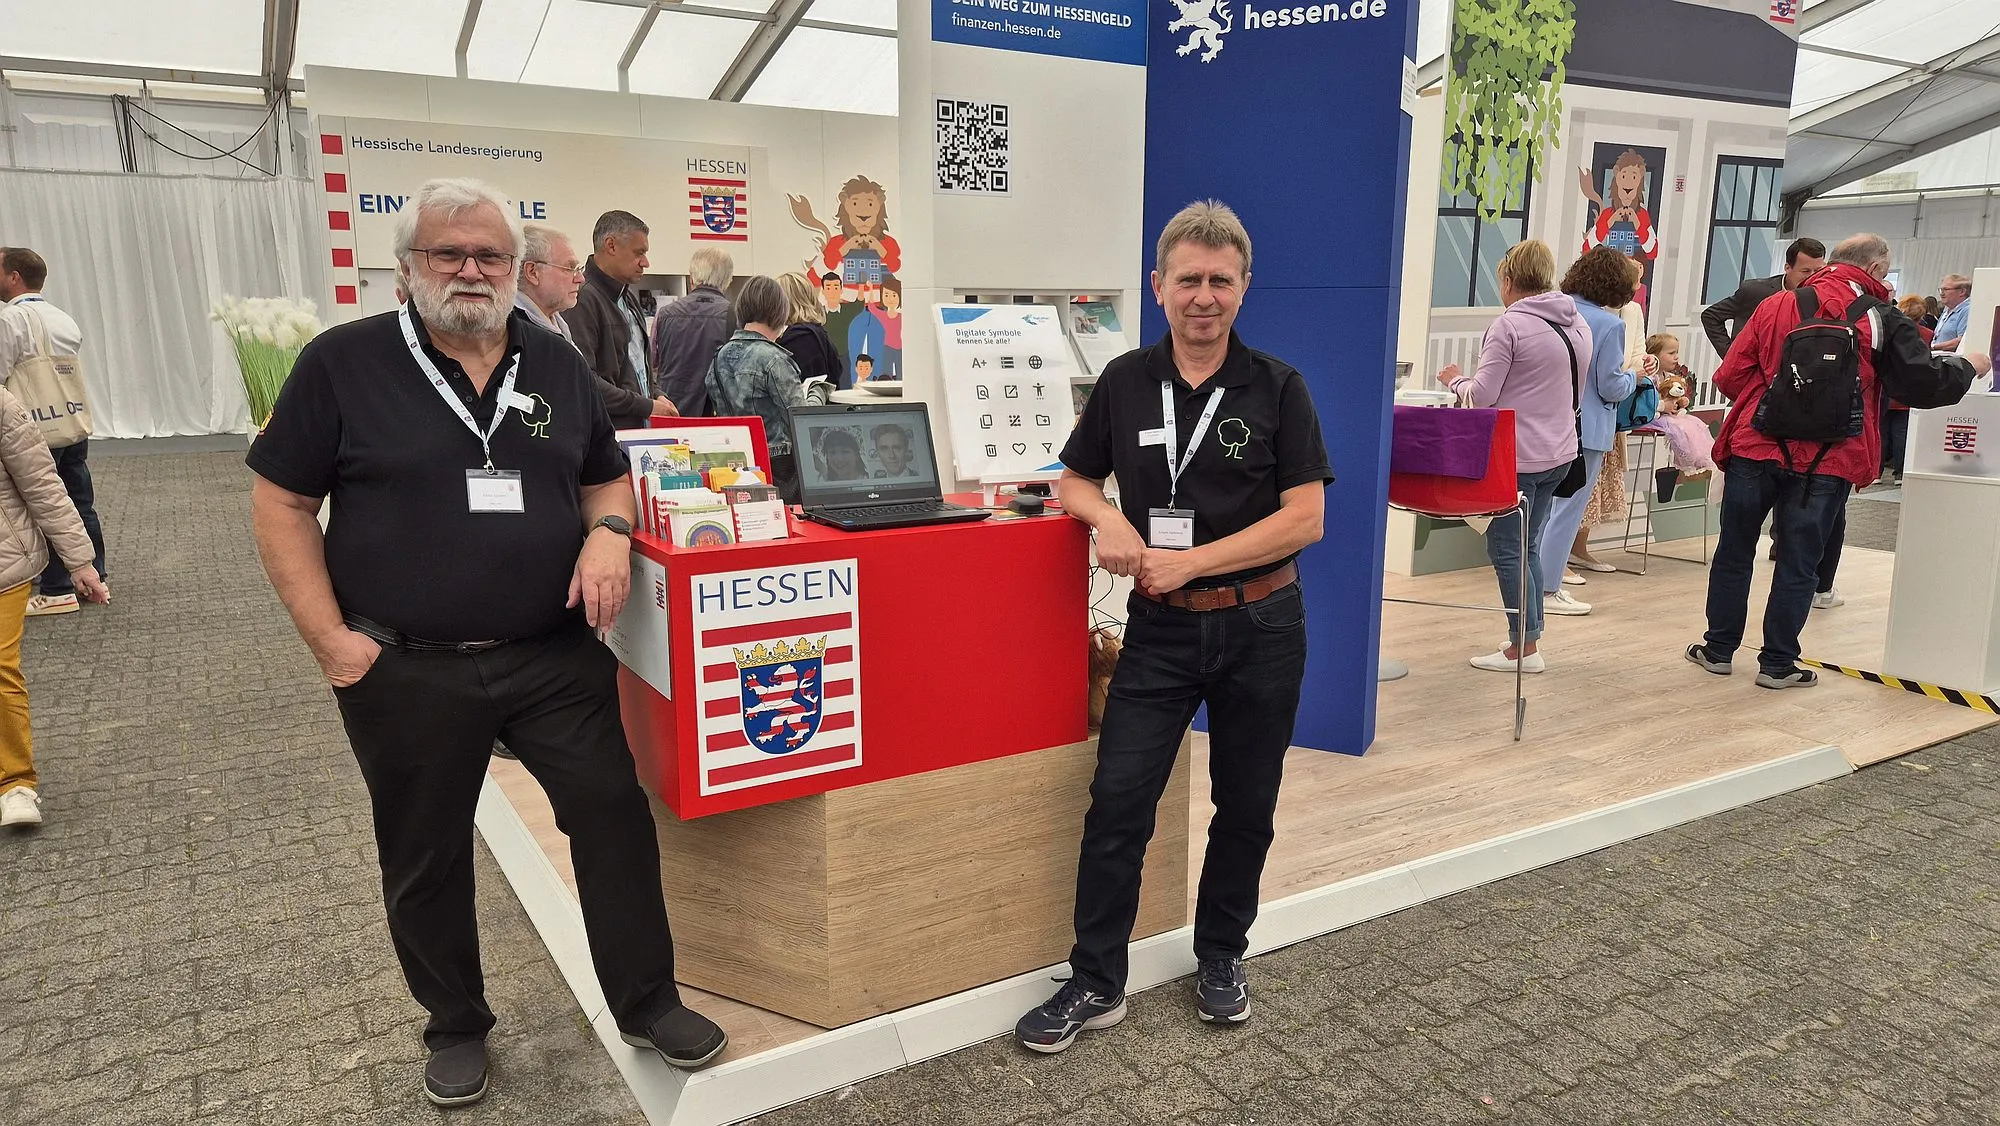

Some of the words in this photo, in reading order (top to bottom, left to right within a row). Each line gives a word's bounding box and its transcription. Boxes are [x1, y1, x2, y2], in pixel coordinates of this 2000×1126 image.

[952, 12, 1062, 39] finanzen.hessen.de
[989, 0, 1019, 12] WEG
[1022, 1, 1050, 17] ZUM
[1054, 5, 1132, 28] HESSENGELD
[1244, 0, 1387, 30] hessen.de
[351, 136, 423, 152] Hessische
[428, 140, 543, 162] Landesregierung
[687, 158, 747, 174] HESSEN
[359, 193, 411, 214] EIN
[955, 329, 987, 338] Digitale
[988, 329, 1022, 338] Symbole
[1947, 416, 1979, 424] HESSEN
[698, 566, 853, 613] HESSEN
